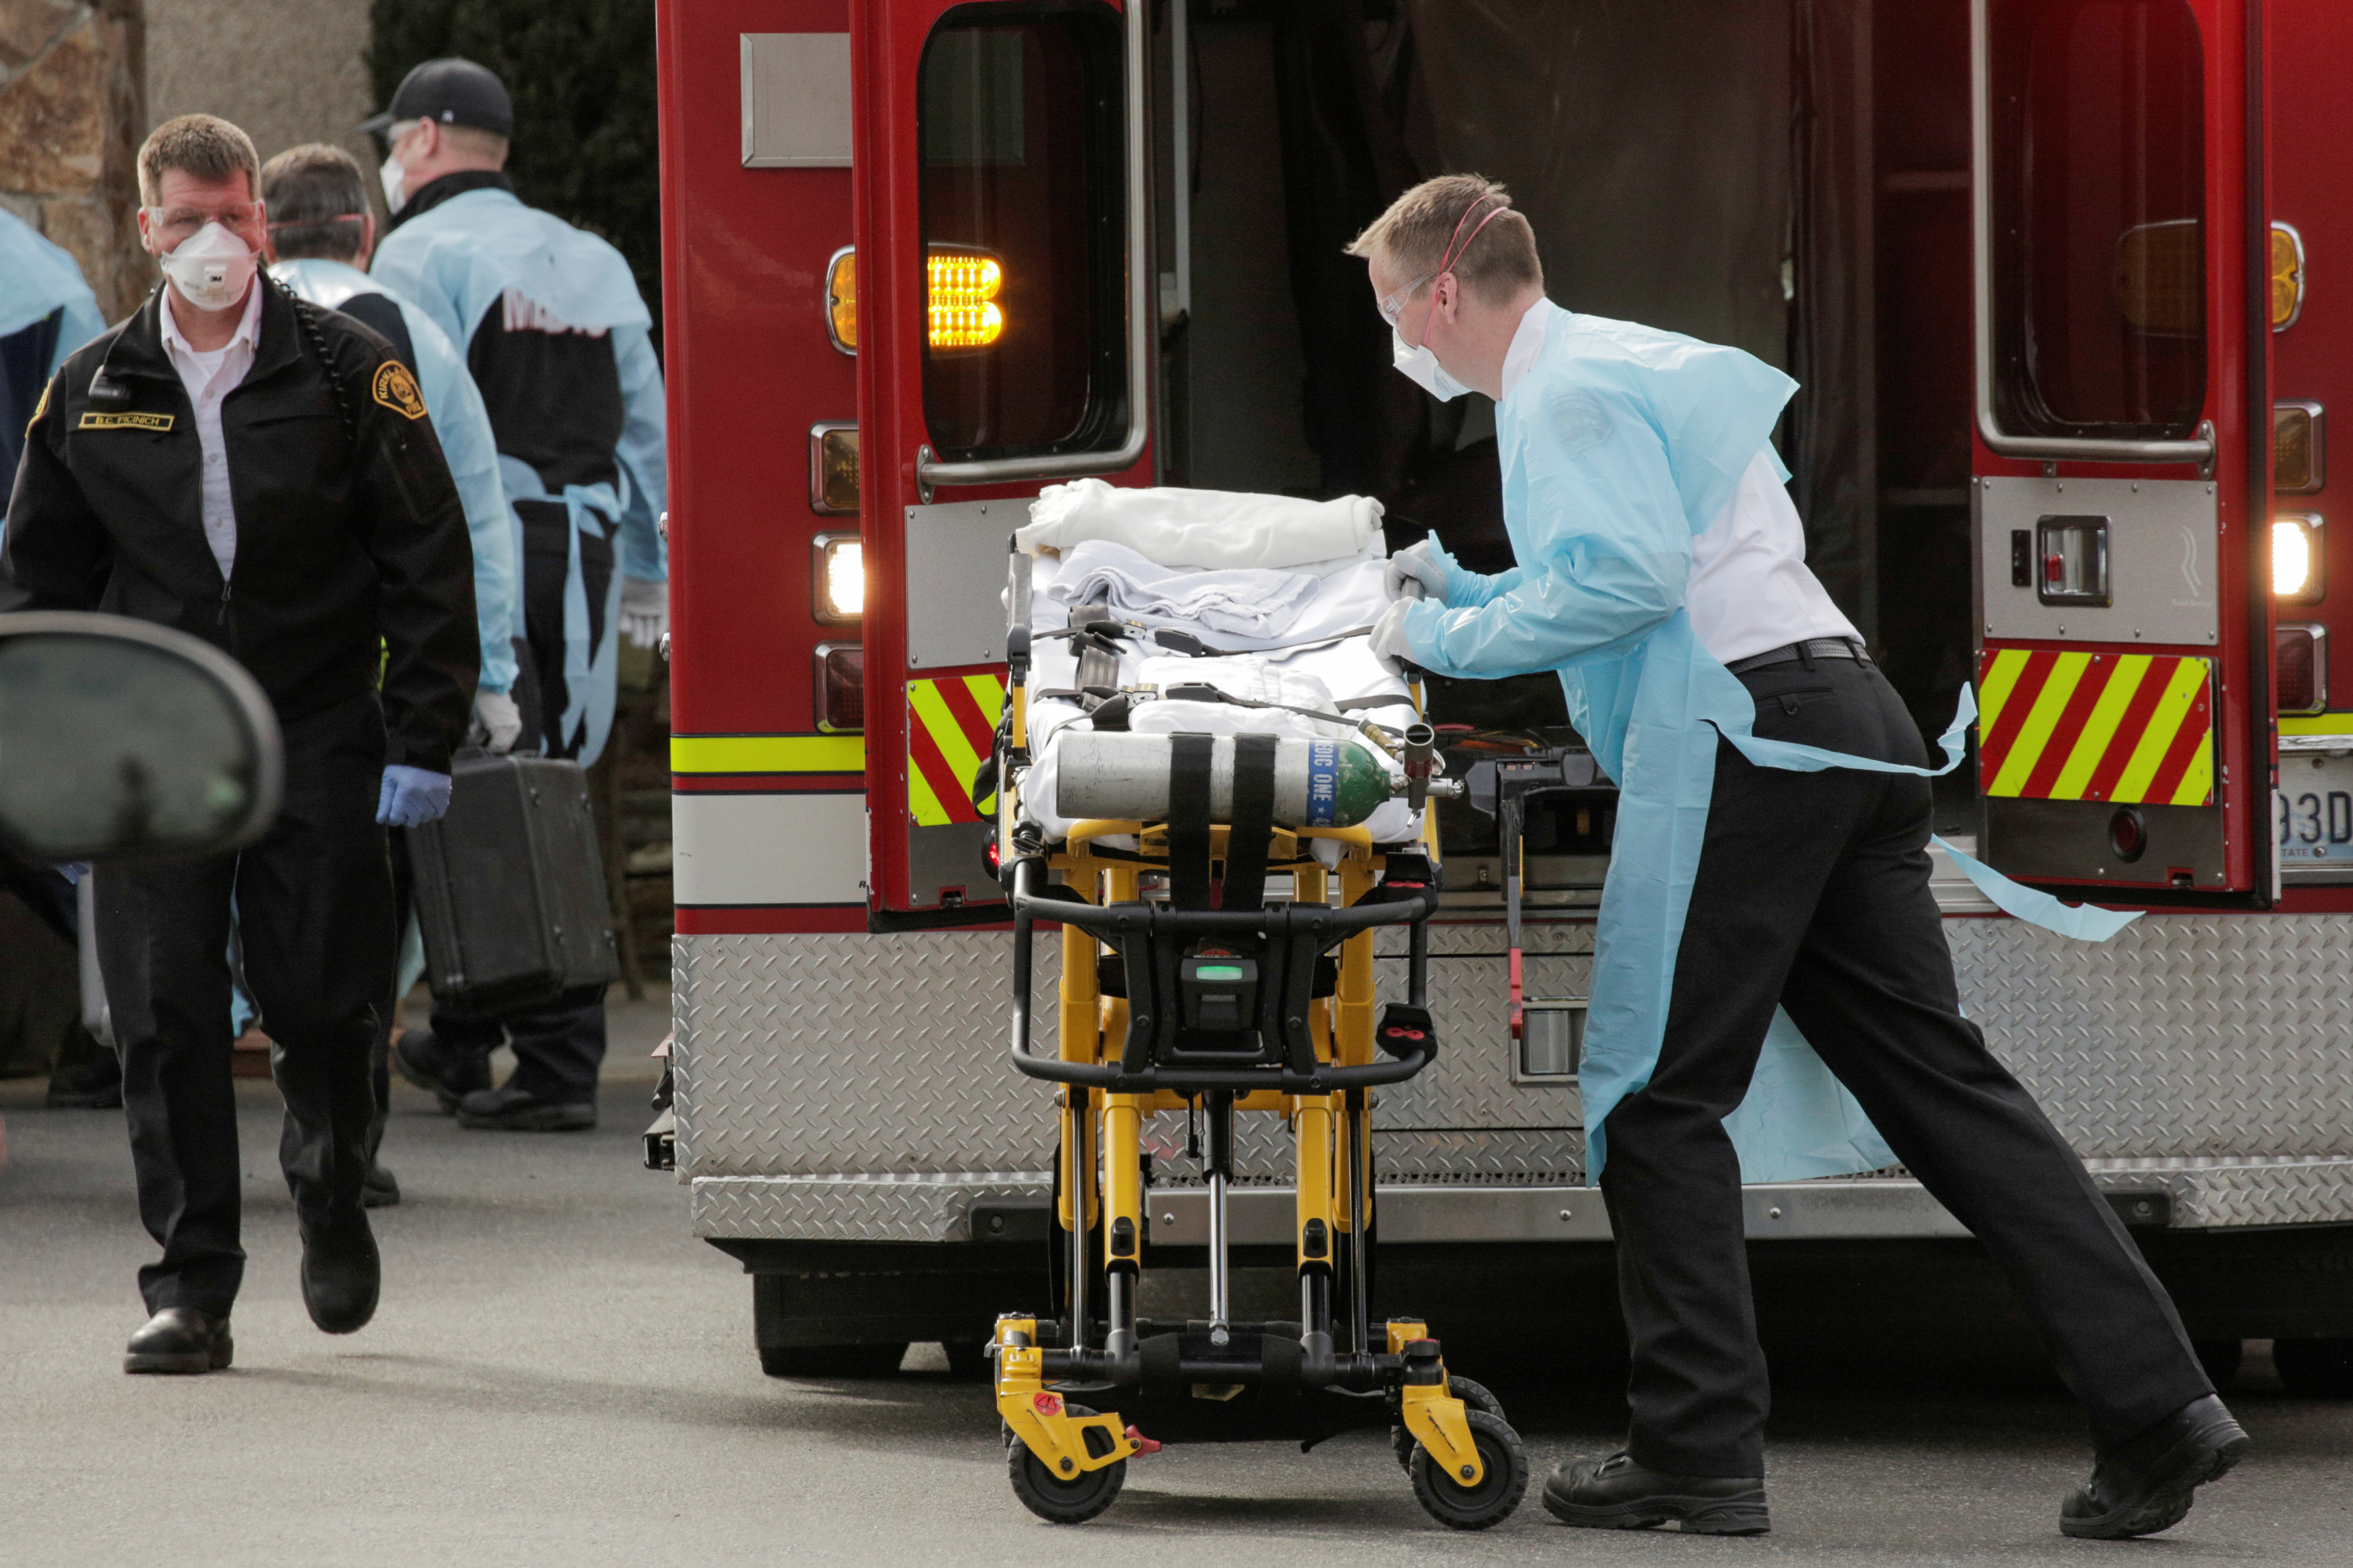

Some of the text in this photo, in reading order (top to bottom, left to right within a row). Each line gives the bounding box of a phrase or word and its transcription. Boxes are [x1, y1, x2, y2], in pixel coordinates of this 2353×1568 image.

[378, 367, 413, 399] KIRKLA
[1313, 774, 1333, 801] ONE
[2280, 848, 2309, 857] TATE
